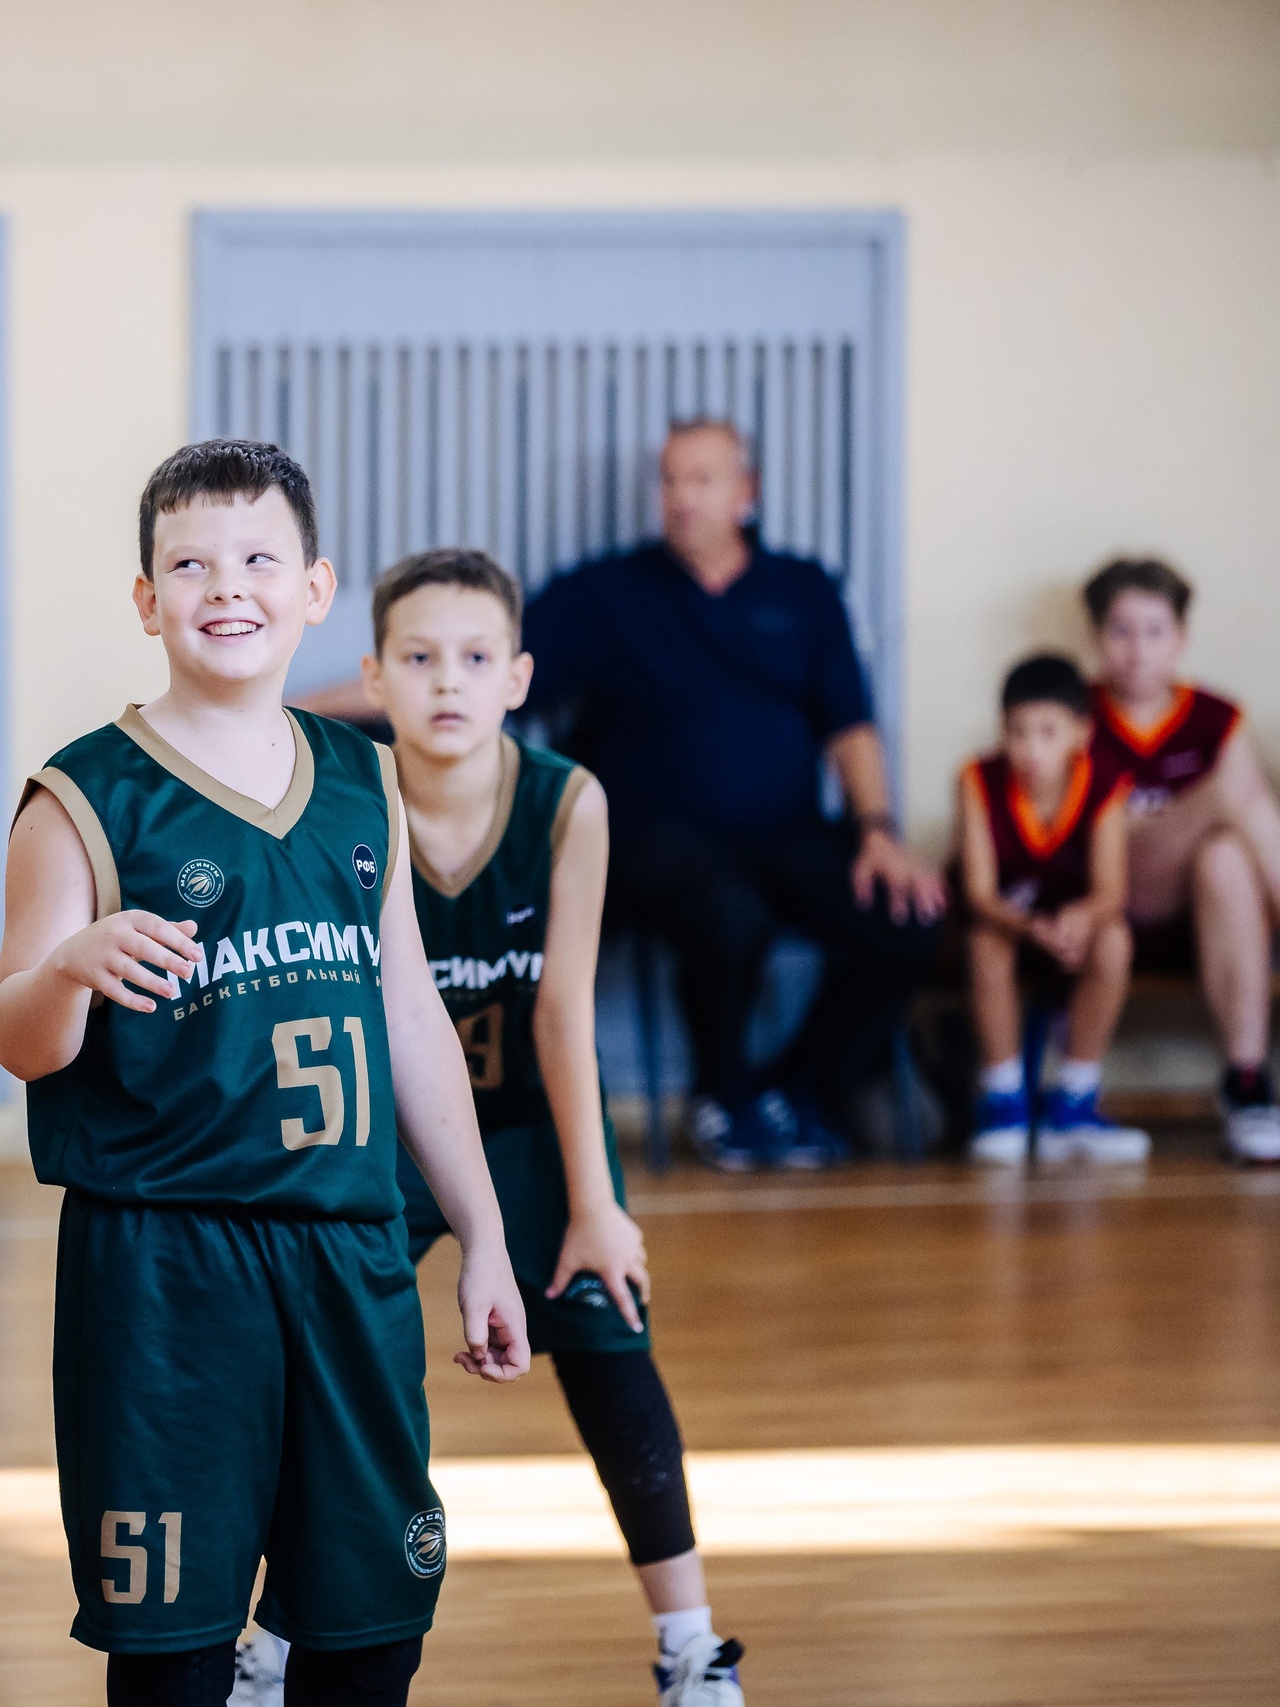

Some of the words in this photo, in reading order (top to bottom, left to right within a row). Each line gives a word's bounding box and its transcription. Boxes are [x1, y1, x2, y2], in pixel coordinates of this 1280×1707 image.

[180, 862, 220, 887] МАКСИМУМ
[356, 859, 375, 874] РФБ
[167, 920, 381, 1001] МАКСИМУ
[428, 950, 544, 990] СИМУ
[173, 969, 361, 1022] БАСКЕТБОЛЬНЫЙ
[271, 1016, 371, 1151] 51
[101, 1510, 182, 1604] 51
